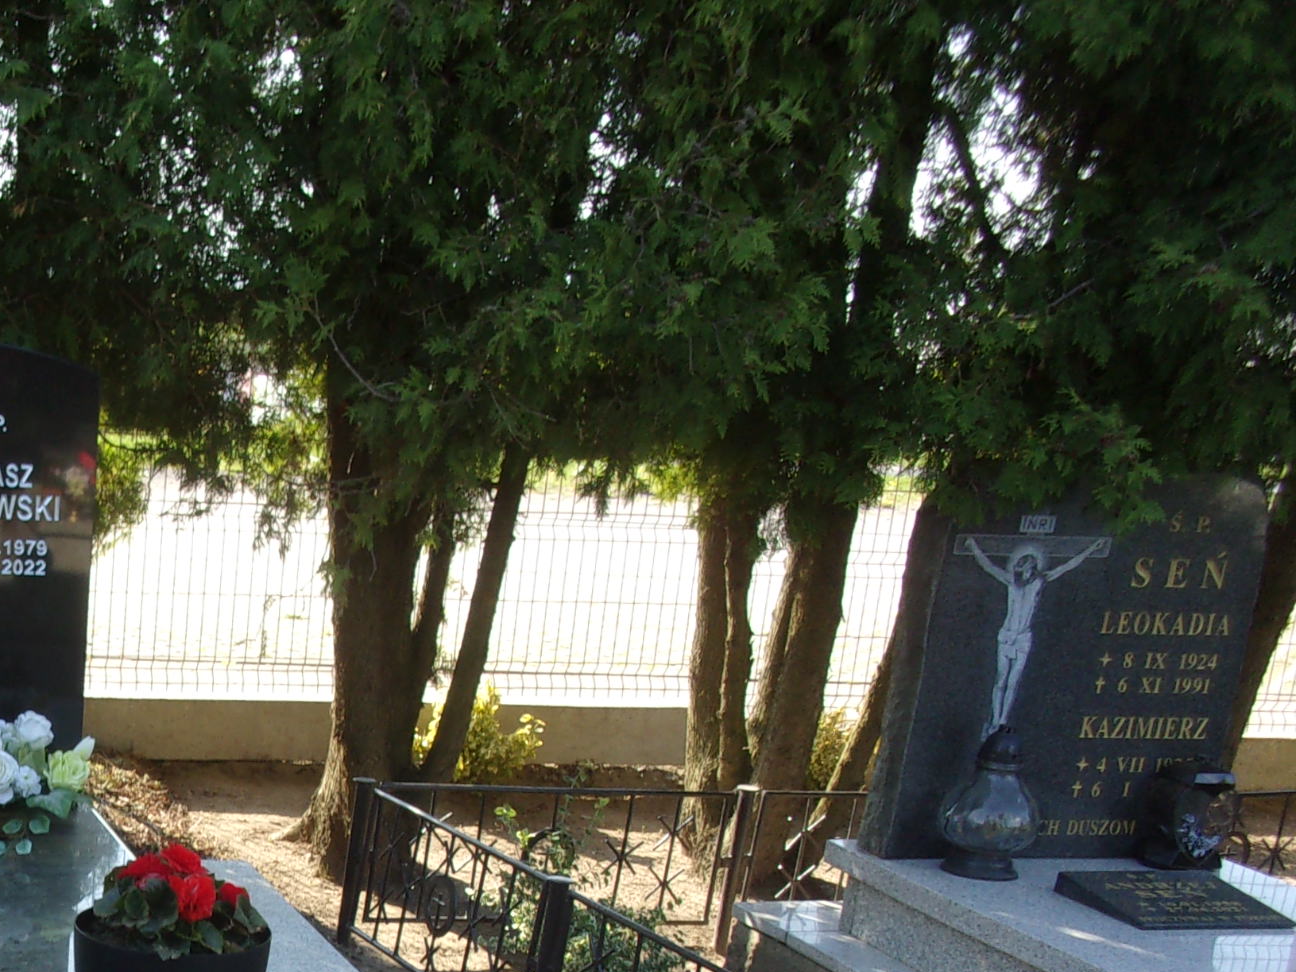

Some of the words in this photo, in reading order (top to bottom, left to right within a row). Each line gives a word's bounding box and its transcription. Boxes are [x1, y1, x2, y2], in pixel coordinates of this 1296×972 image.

[1130, 551, 1229, 589] SEŃ
[1099, 610, 1231, 637] LEOKADIA
[1123, 651, 1135, 669] 8
[1144, 652, 1168, 670] IX
[1179, 652, 1219, 671] 1924
[1117, 676, 1129, 693] 6
[1138, 676, 1164, 694] XI
[1172, 677, 1212, 694] 1991
[1078, 715, 1209, 740] KAZIMIERZ
[1096, 756, 1107, 773] 4
[1115, 756, 1147, 773] VII
[1090, 781, 1101, 798] 6
[1121, 781, 1132, 798] I
[1066, 818, 1137, 836] DUSZOM
